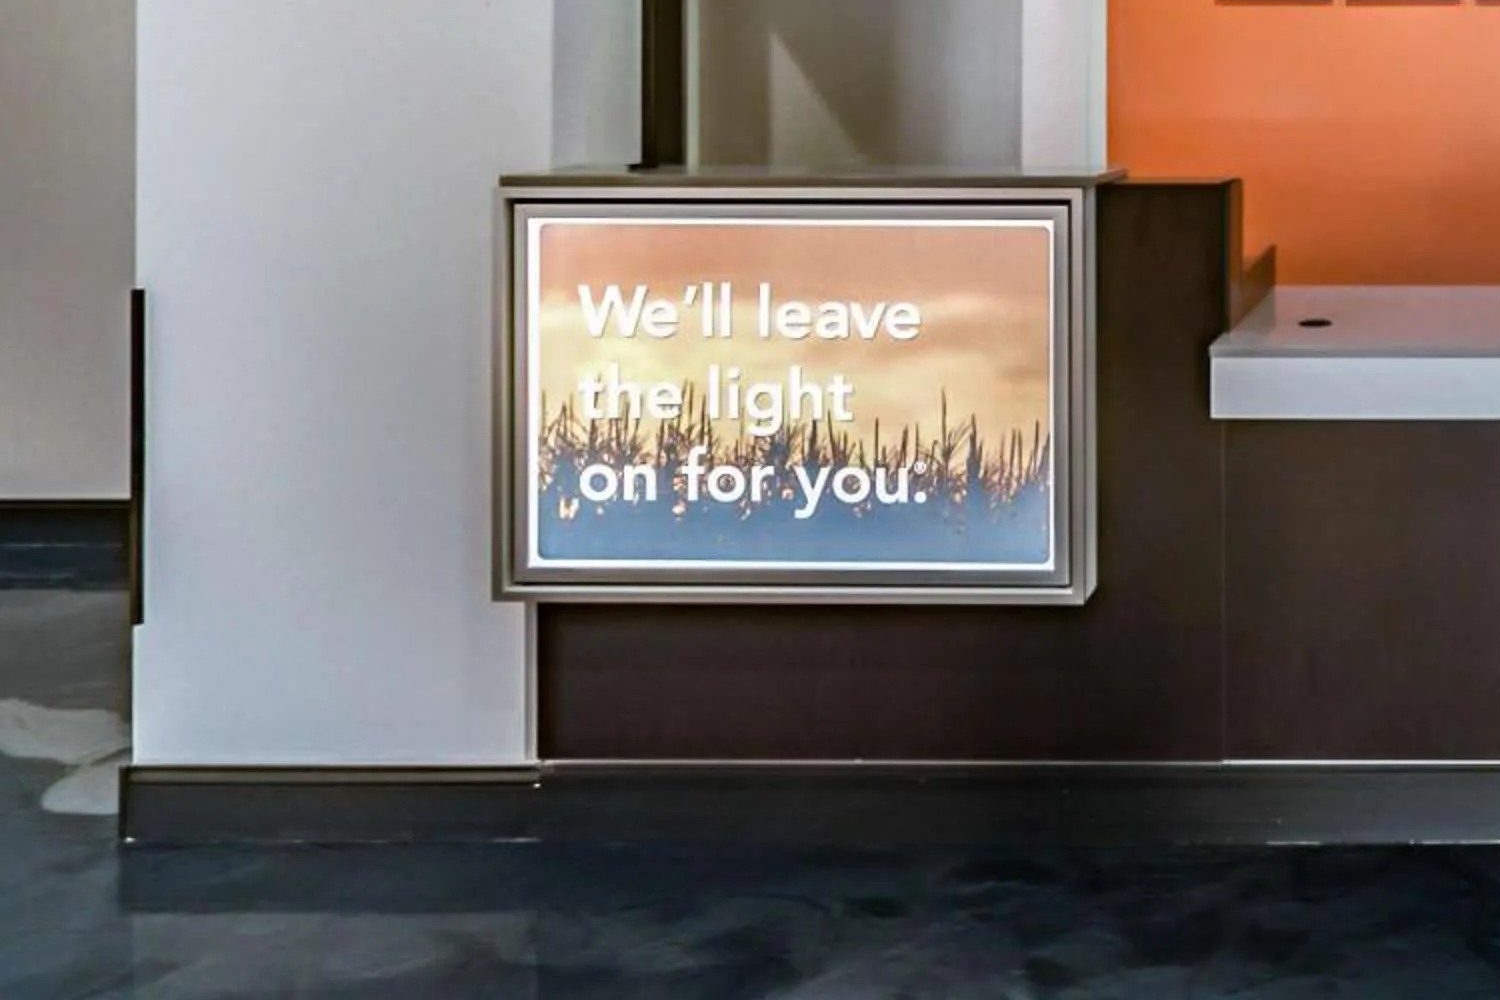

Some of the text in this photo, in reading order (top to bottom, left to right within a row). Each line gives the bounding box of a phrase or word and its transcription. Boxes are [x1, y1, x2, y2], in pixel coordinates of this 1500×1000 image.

[576, 281, 922, 340] We'll leave
[576, 362, 855, 437] the light
[579, 464, 658, 503] on
[686, 446, 776, 503] for
